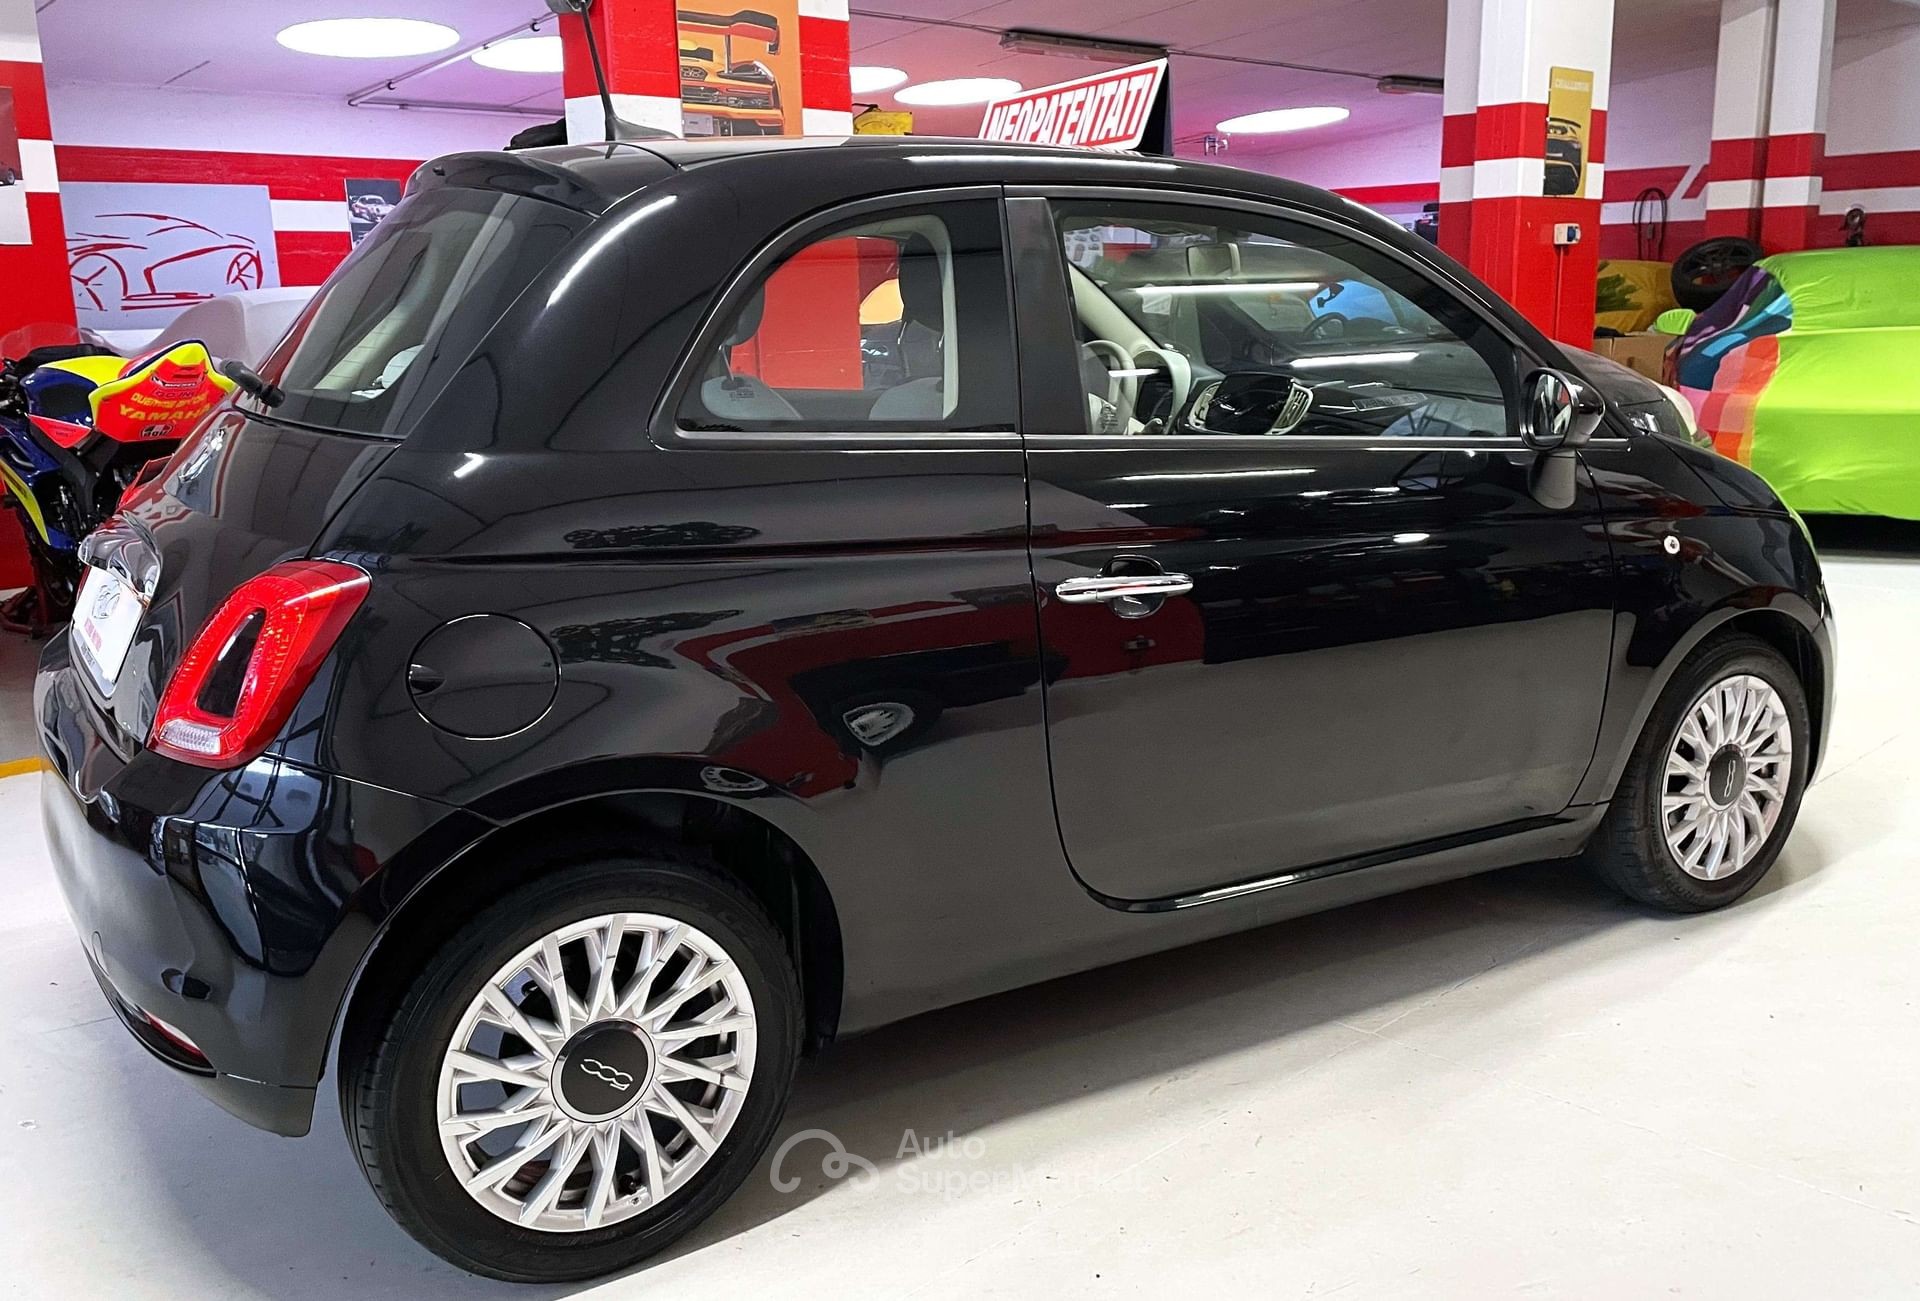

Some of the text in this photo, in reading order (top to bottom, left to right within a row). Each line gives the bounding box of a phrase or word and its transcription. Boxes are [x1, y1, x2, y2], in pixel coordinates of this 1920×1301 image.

[986, 72, 1155, 145] NEOPATENTATI
[120, 403, 211, 420] YAMAHA
[580, 1058, 634, 1091] 500
